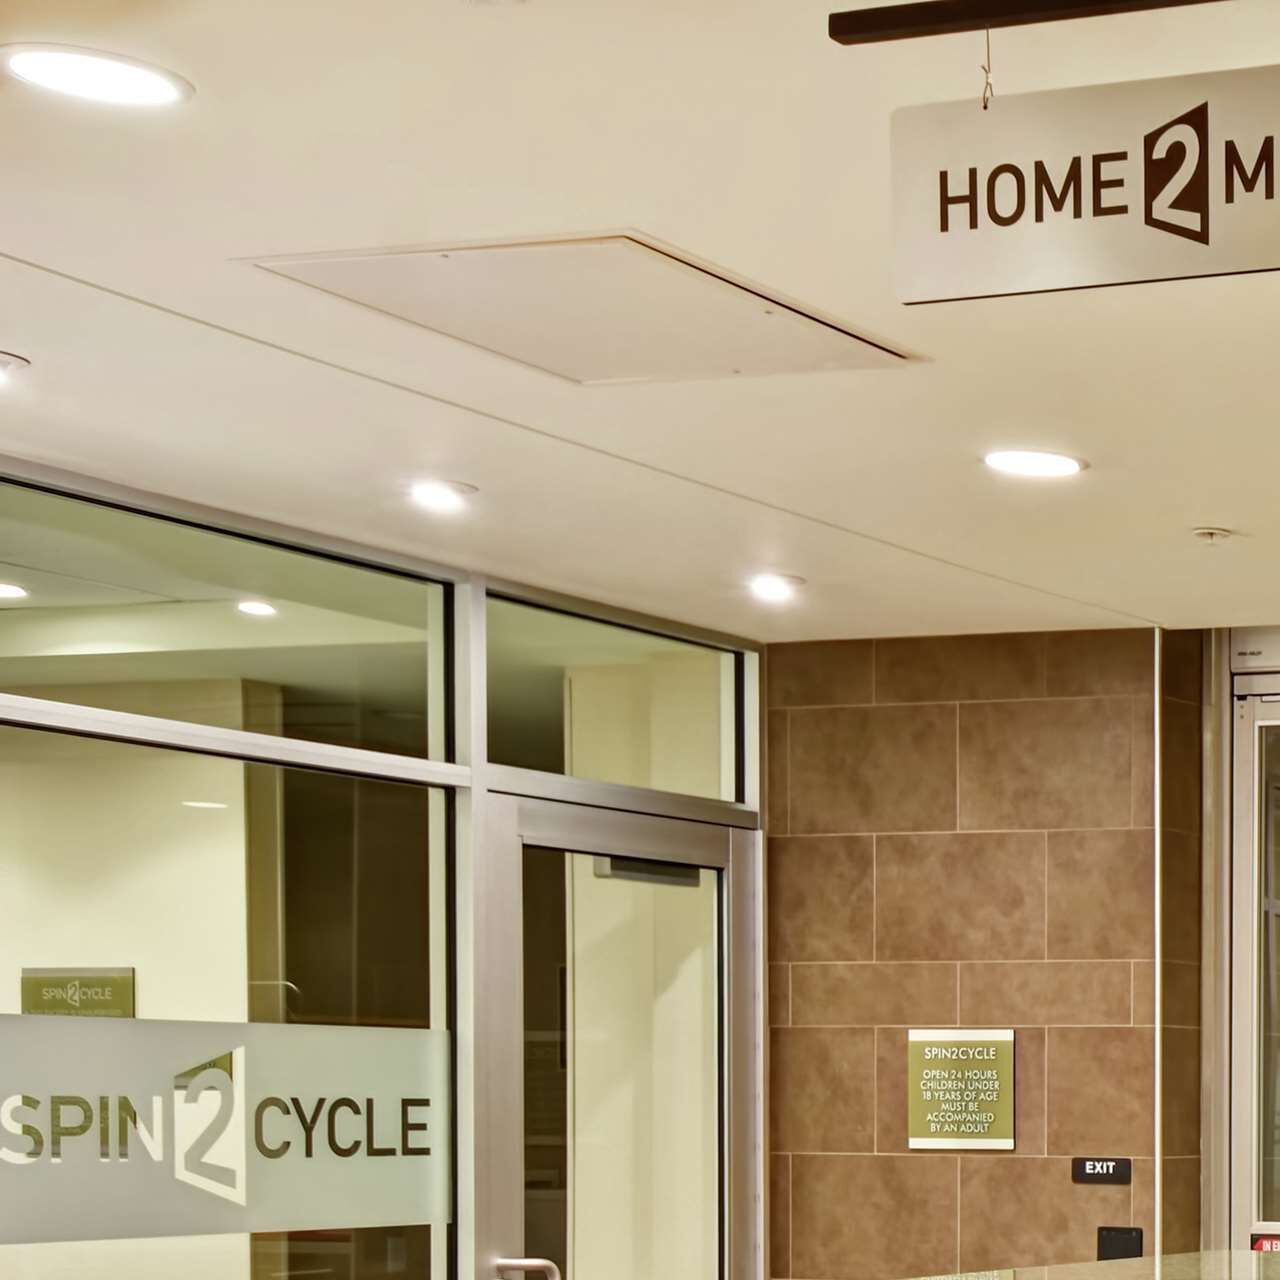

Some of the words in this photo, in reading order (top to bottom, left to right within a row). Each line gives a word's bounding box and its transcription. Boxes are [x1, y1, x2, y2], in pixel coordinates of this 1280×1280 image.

[939, 151, 1129, 232] HOME
[924, 1048, 996, 1059] SPIN2CYCLE
[923, 1070, 948, 1079] OPEN
[951, 1071, 961, 1079] 24
[965, 1070, 997, 1079] HOURS
[920, 1081, 965, 1089] CHILDREN
[968, 1081, 999, 1090] UNDER
[923, 1091, 931, 1100] 18
[934, 1092, 961, 1100] YEARS
[964, 1092, 976, 1100] OF
[979, 1092, 999, 1100] AGE
[941, 1102, 966, 1111] MUST
[969, 1102, 979, 1111] BE
[927, 1113, 994, 1121] ACCOMPANIED
[255, 1097, 431, 1159] CYCLE
[931, 1123, 941, 1132] BY
[944, 1124, 957, 1132] AN
[960, 1124, 989, 1132] ADULT
[1085, 1161, 1115, 1174] EXIT
[1263, 1240, 1271, 1251] IN
